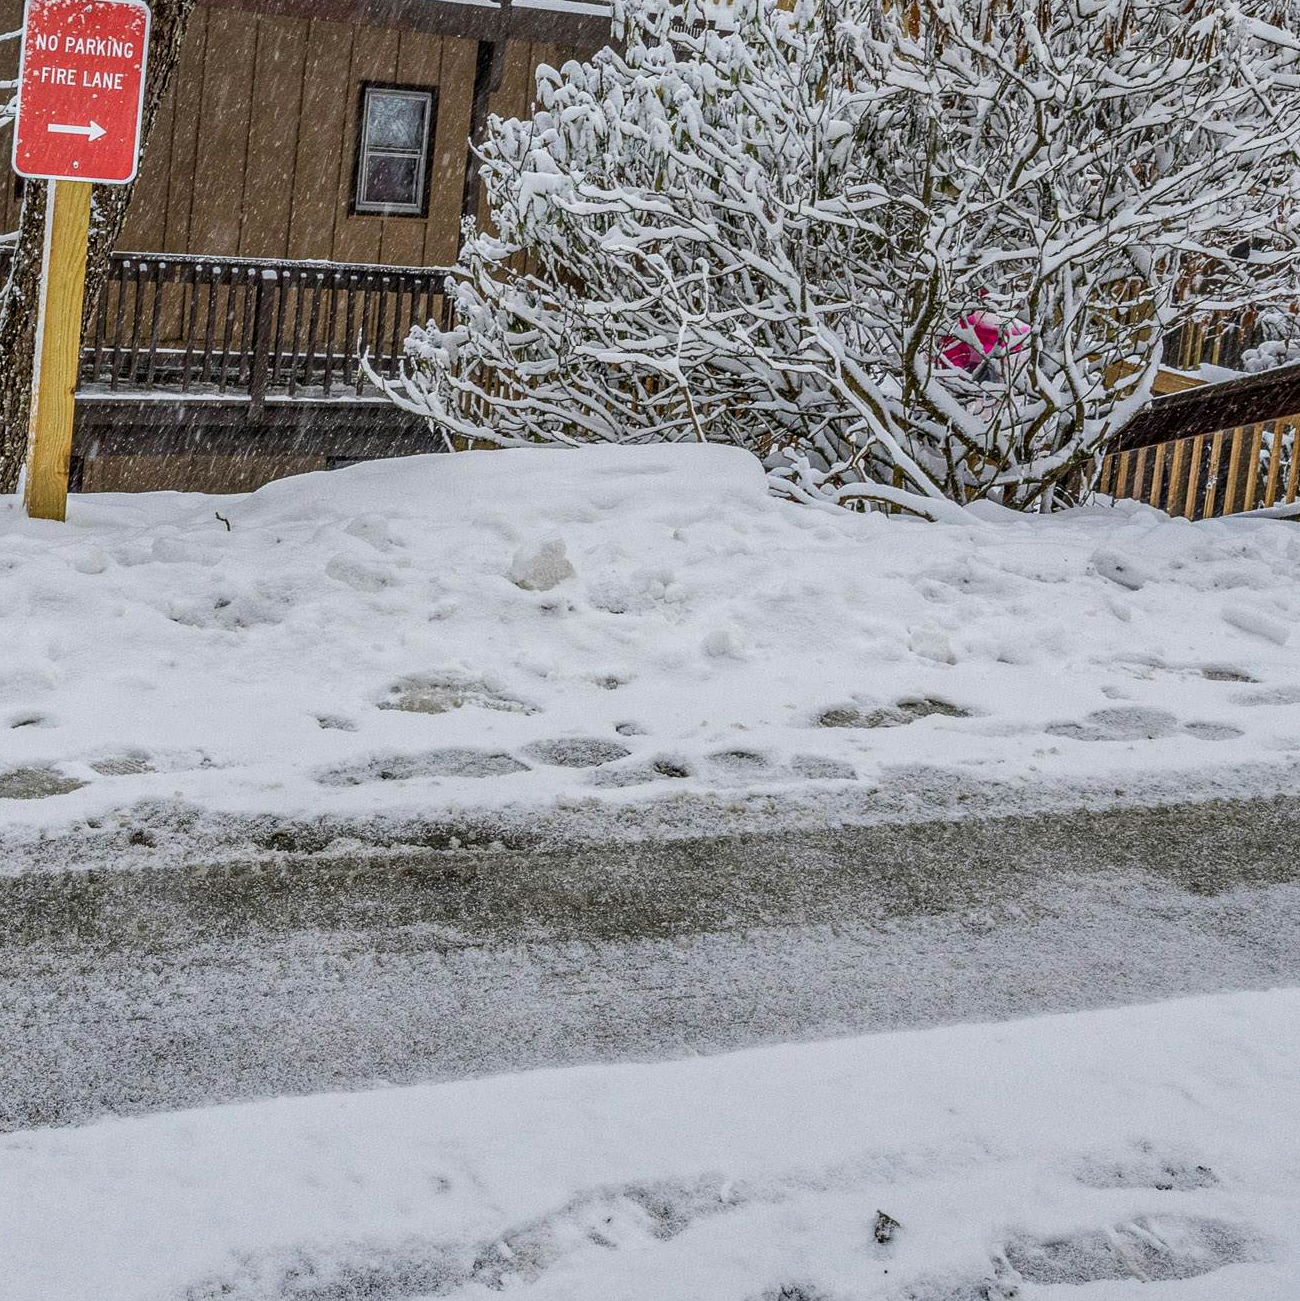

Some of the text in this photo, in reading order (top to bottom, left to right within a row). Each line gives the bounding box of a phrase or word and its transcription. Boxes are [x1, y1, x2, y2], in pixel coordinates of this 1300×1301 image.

[35, 34, 134, 59] NO PARKING
[41, 66, 124, 90] FIRE LANE
